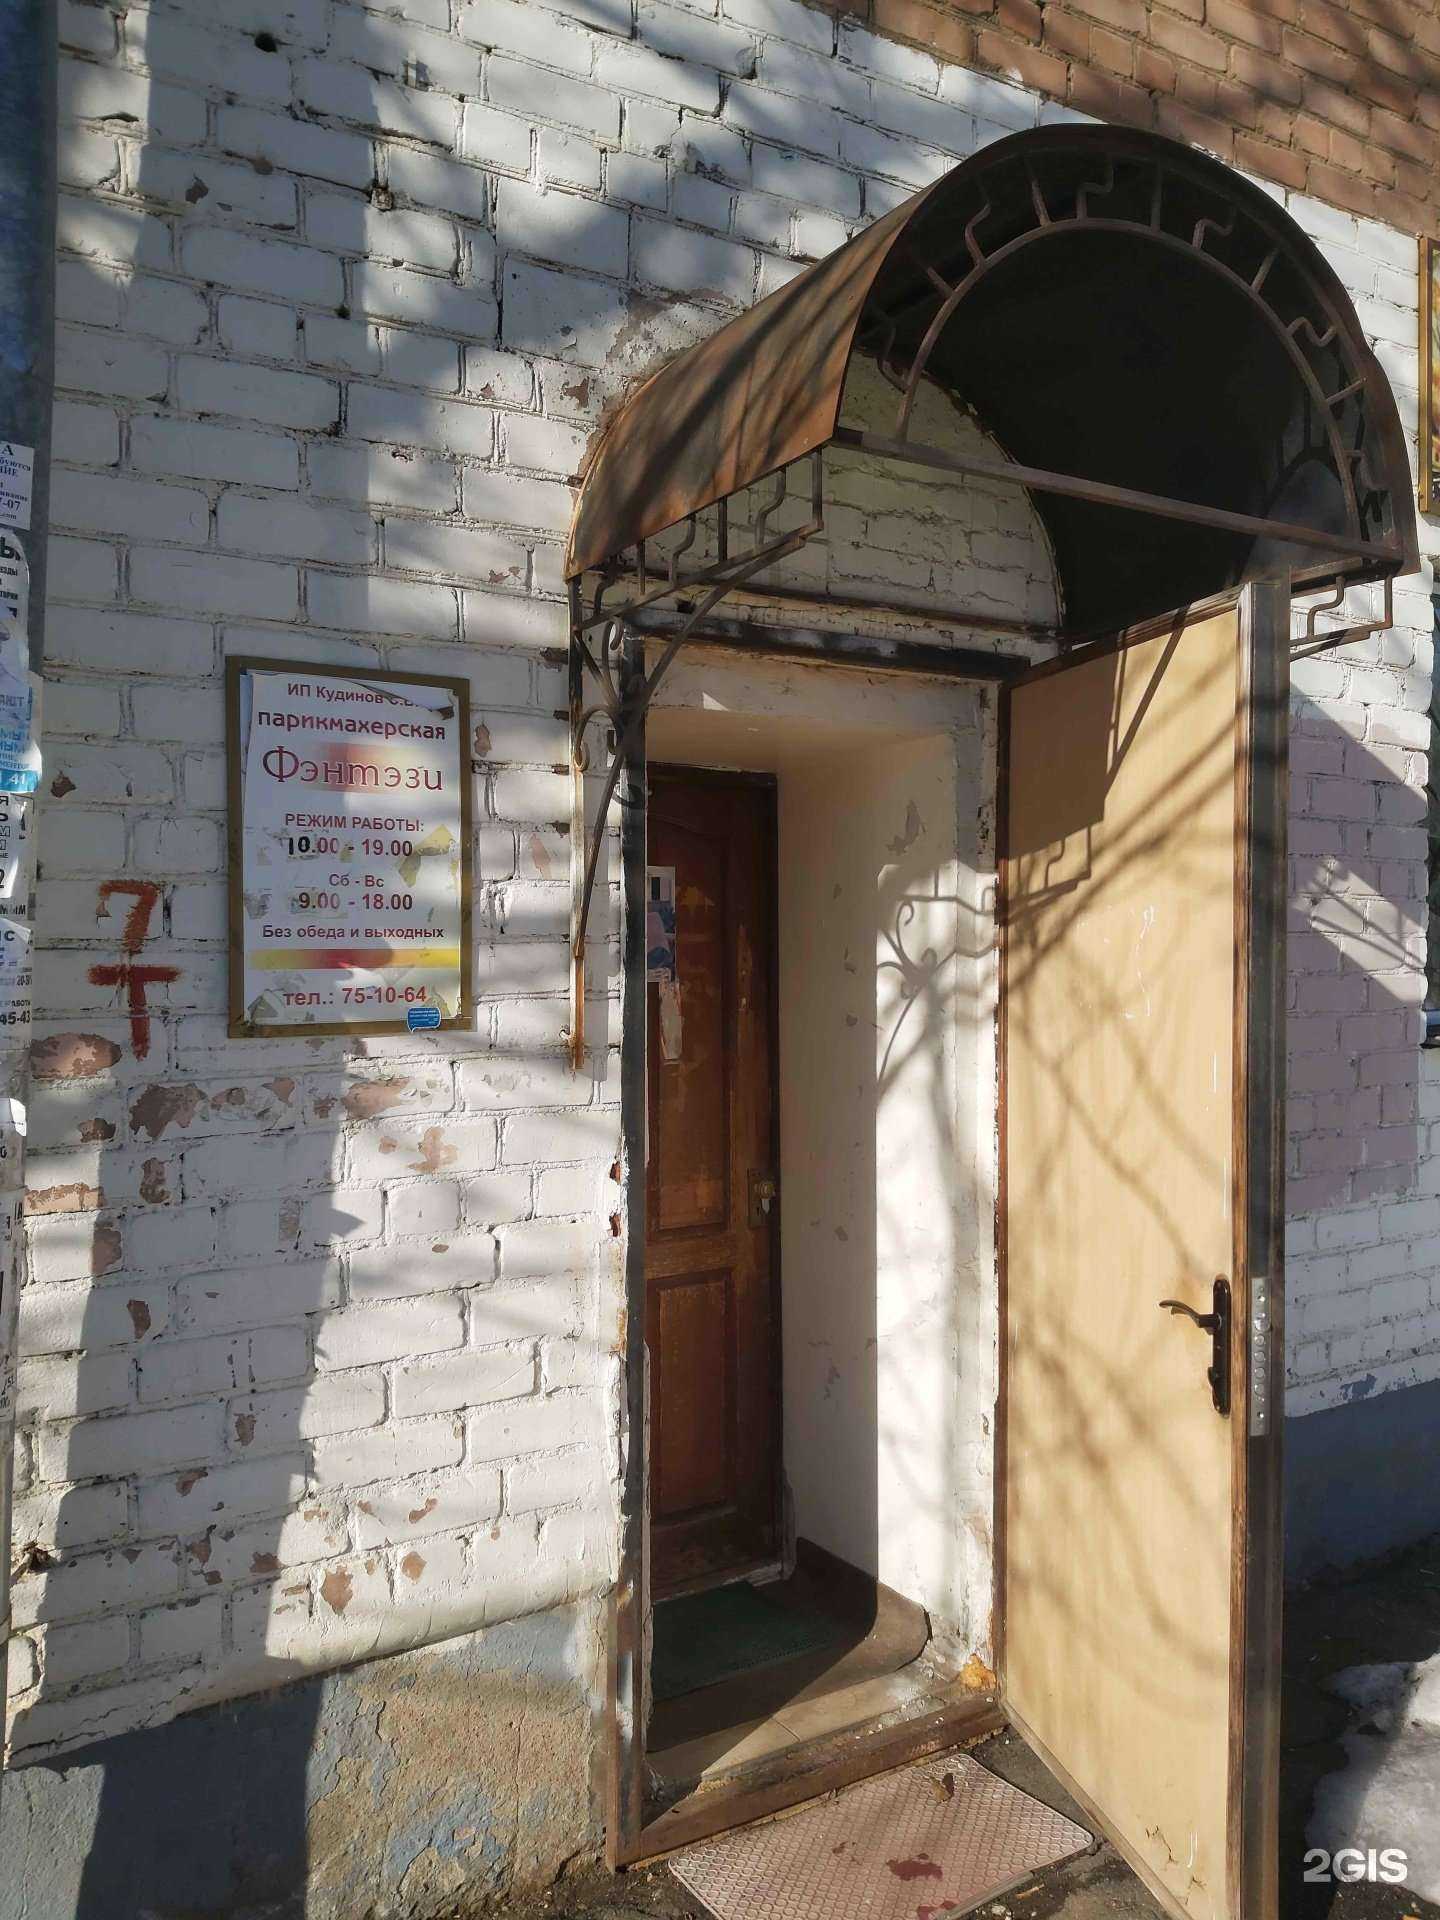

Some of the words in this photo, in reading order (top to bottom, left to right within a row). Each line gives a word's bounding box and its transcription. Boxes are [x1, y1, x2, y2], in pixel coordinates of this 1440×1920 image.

[288, 683, 311, 697] ИП
[258, 711, 446, 740] парикмахерская
[262, 745, 443, 791] Фэнтэзи
[284, 812, 347, 829] РЕЖИМ
[352, 816, 425, 833] РАБОТЫ:
[289, 836, 340, 856] 10.00
[362, 838, 413, 857] 19.00
[328, 872, 350, 887] Сб
[364, 874, 385, 888] Вс
[298, 892, 340, 910] 9.00
[362, 893, 413, 911] 18.00
[262, 925, 292, 938] Без
[297, 926, 345, 940] обеда
[349, 929, 360, 938] и
[363, 928, 445, 940] выходных
[283, 990, 334, 1006] тел.:
[341, 985, 427, 1004] 75-10-64
